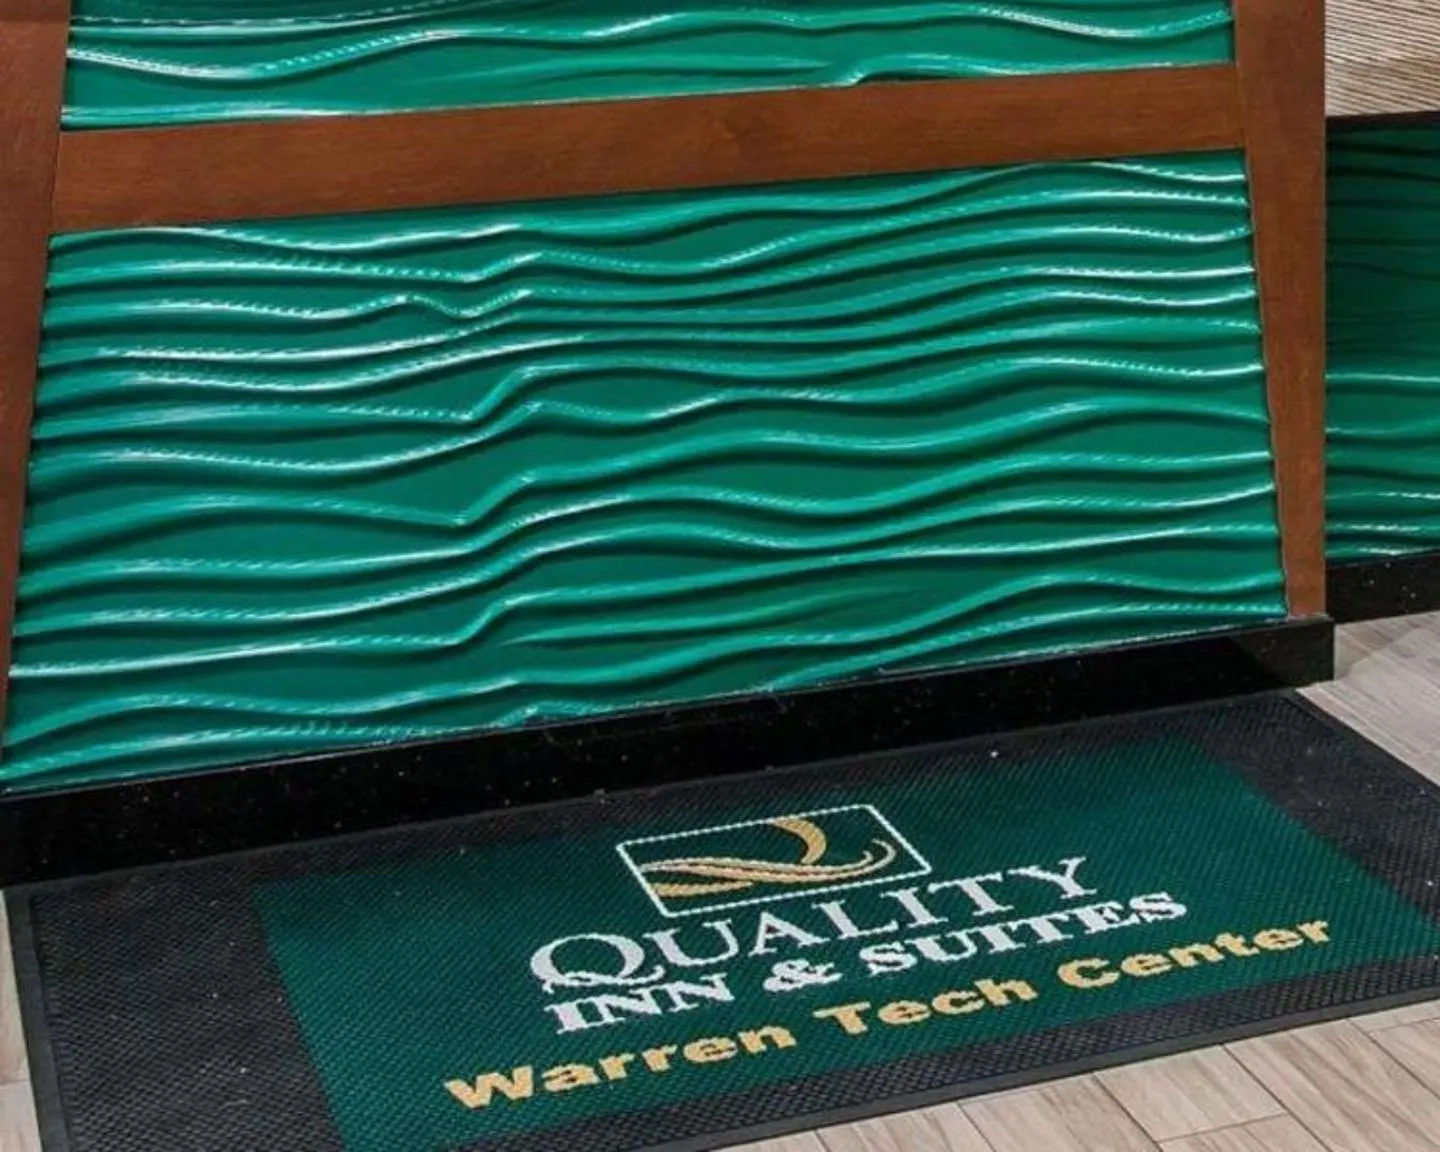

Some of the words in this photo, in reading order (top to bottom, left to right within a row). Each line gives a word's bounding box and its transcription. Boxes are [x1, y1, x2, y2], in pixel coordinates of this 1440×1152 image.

[530, 856, 1098, 994] QUALITY
[544, 970, 735, 1035] INN
[762, 957, 844, 993] &
[858, 891, 1188, 974] SUITES
[443, 1023, 797, 1110] Warren
[812, 977, 1039, 1036] Tech
[1057, 918, 1331, 989] Center
